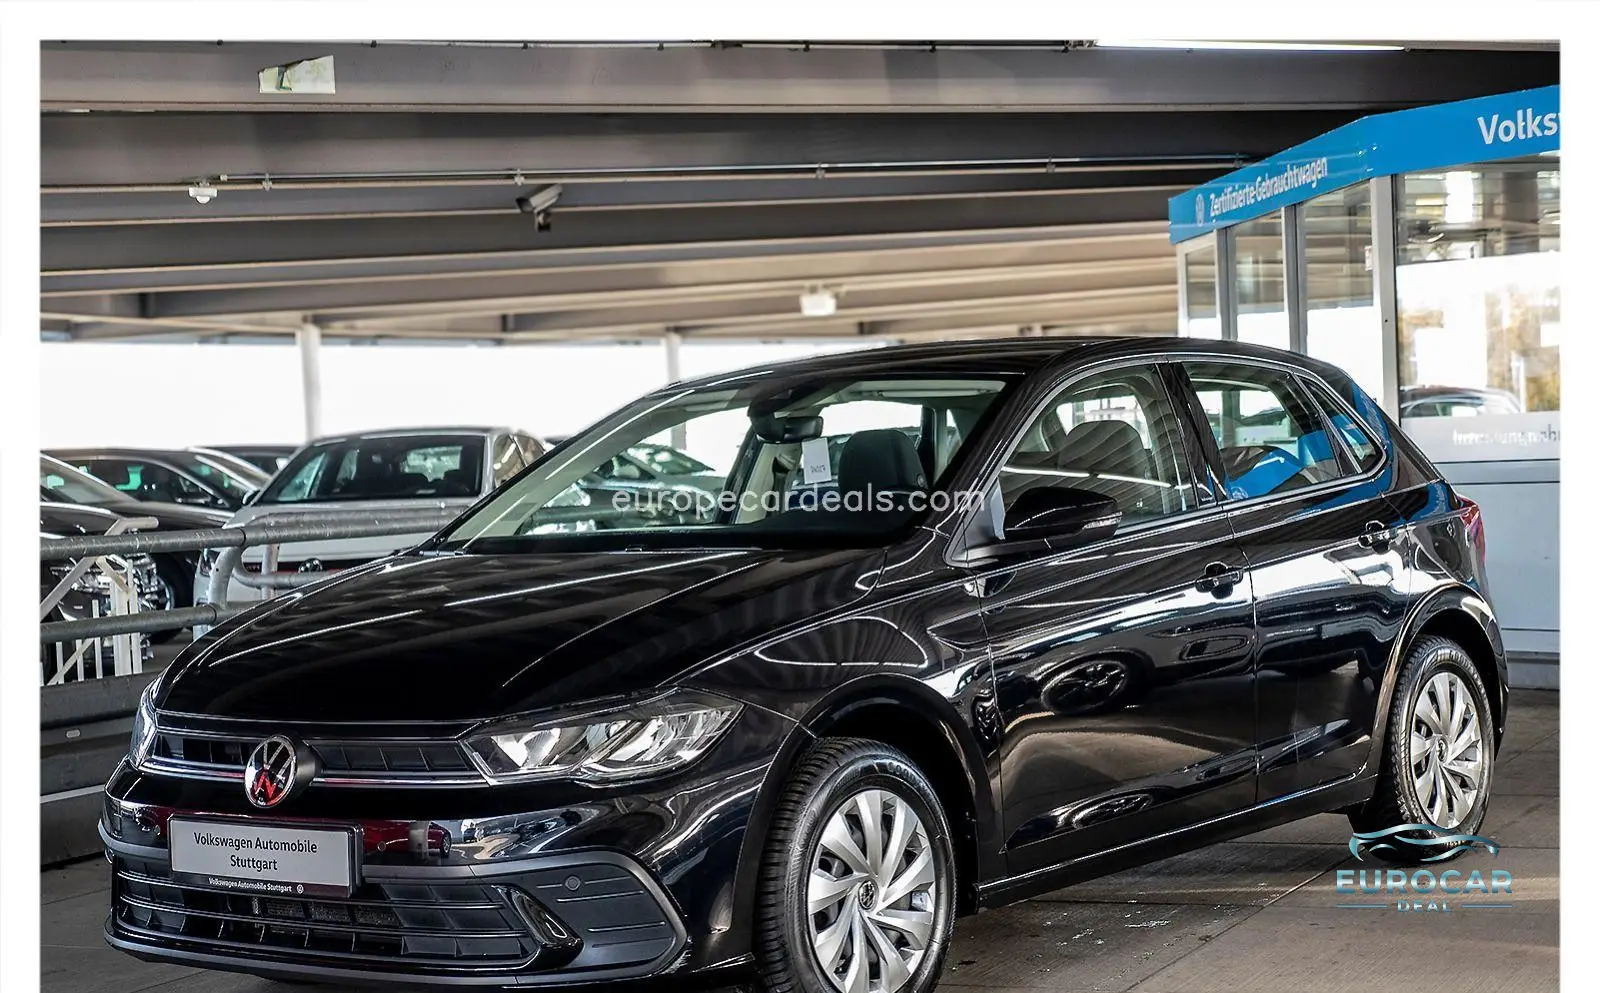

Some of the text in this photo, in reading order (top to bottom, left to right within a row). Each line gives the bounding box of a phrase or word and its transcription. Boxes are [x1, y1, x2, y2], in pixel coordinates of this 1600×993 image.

[1477, 107, 1560, 145] Volks
[193, 832, 318, 854] Volkswagen Automobile
[230, 855, 278, 872] Stuttgart
[208, 877, 238, 889] Volkswagen
[237, 880, 267, 891] Automobile
[266, 882, 292, 893] Stuttgart
